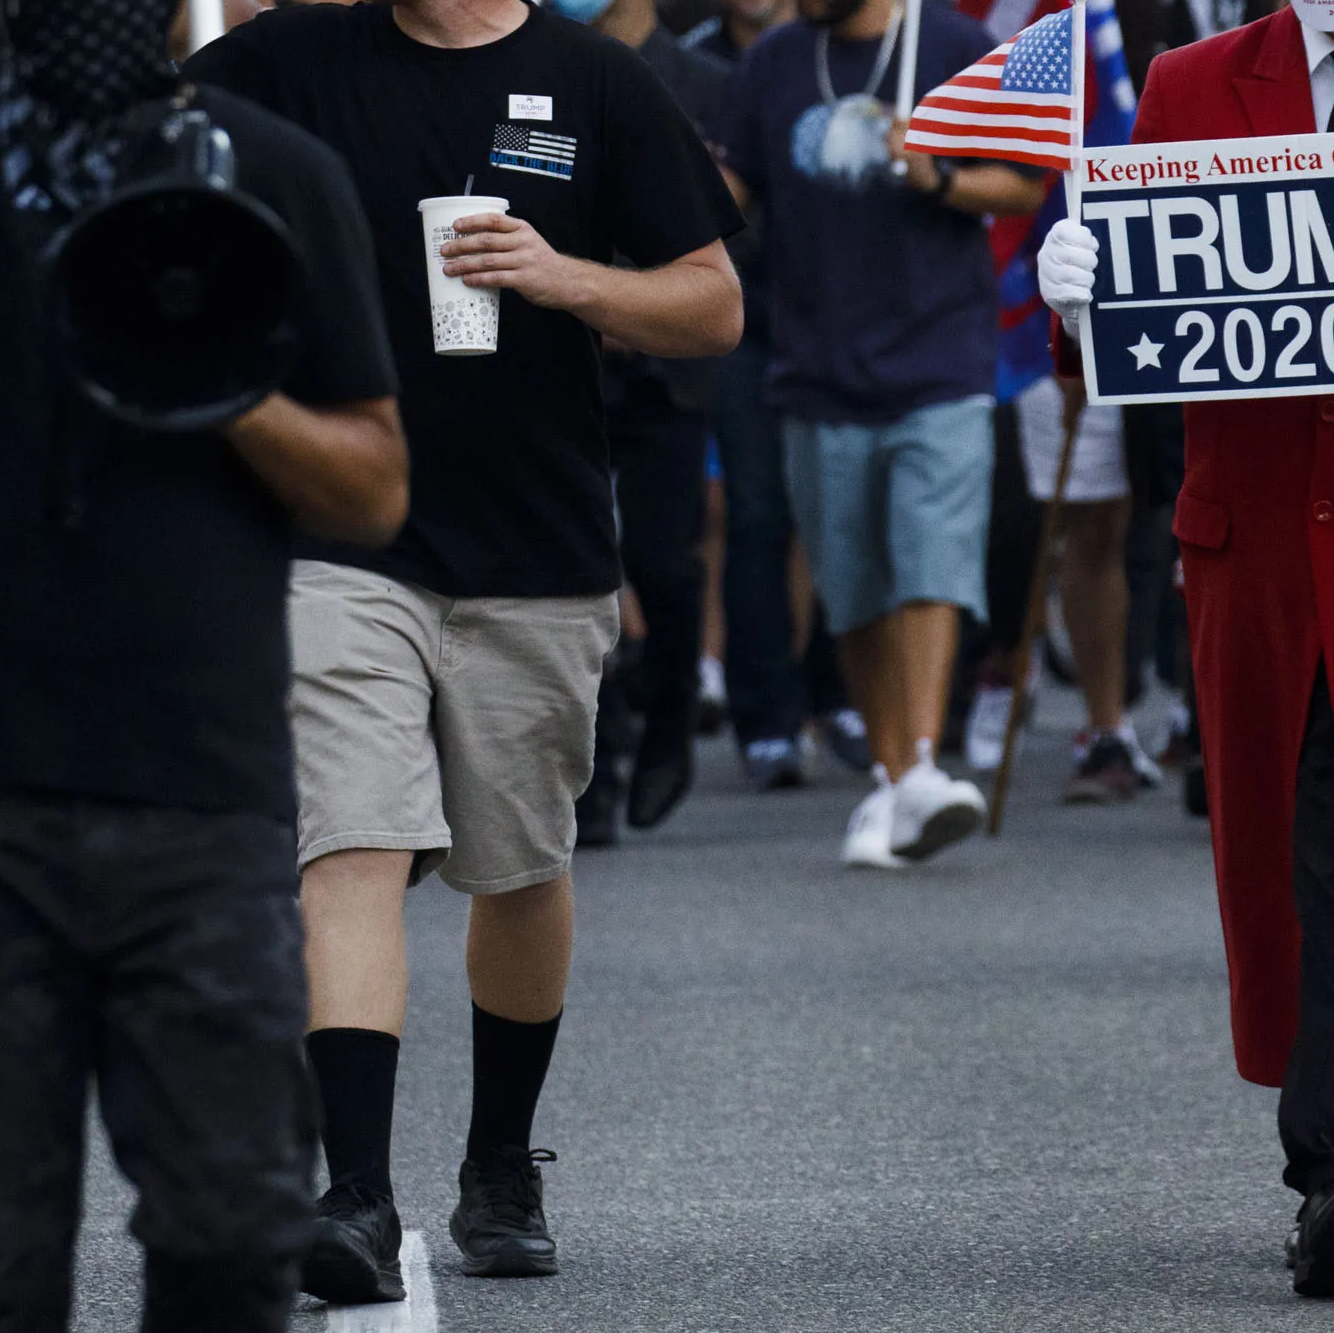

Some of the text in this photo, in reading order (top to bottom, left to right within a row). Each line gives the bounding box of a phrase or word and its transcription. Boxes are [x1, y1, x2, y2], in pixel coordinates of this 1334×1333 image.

[515, 103, 547, 112] TRUMP
[489, 152, 574, 177] BACK THE BLUE
[1087, 156, 1201, 186] Keeping
[1208, 148, 1323, 177] America
